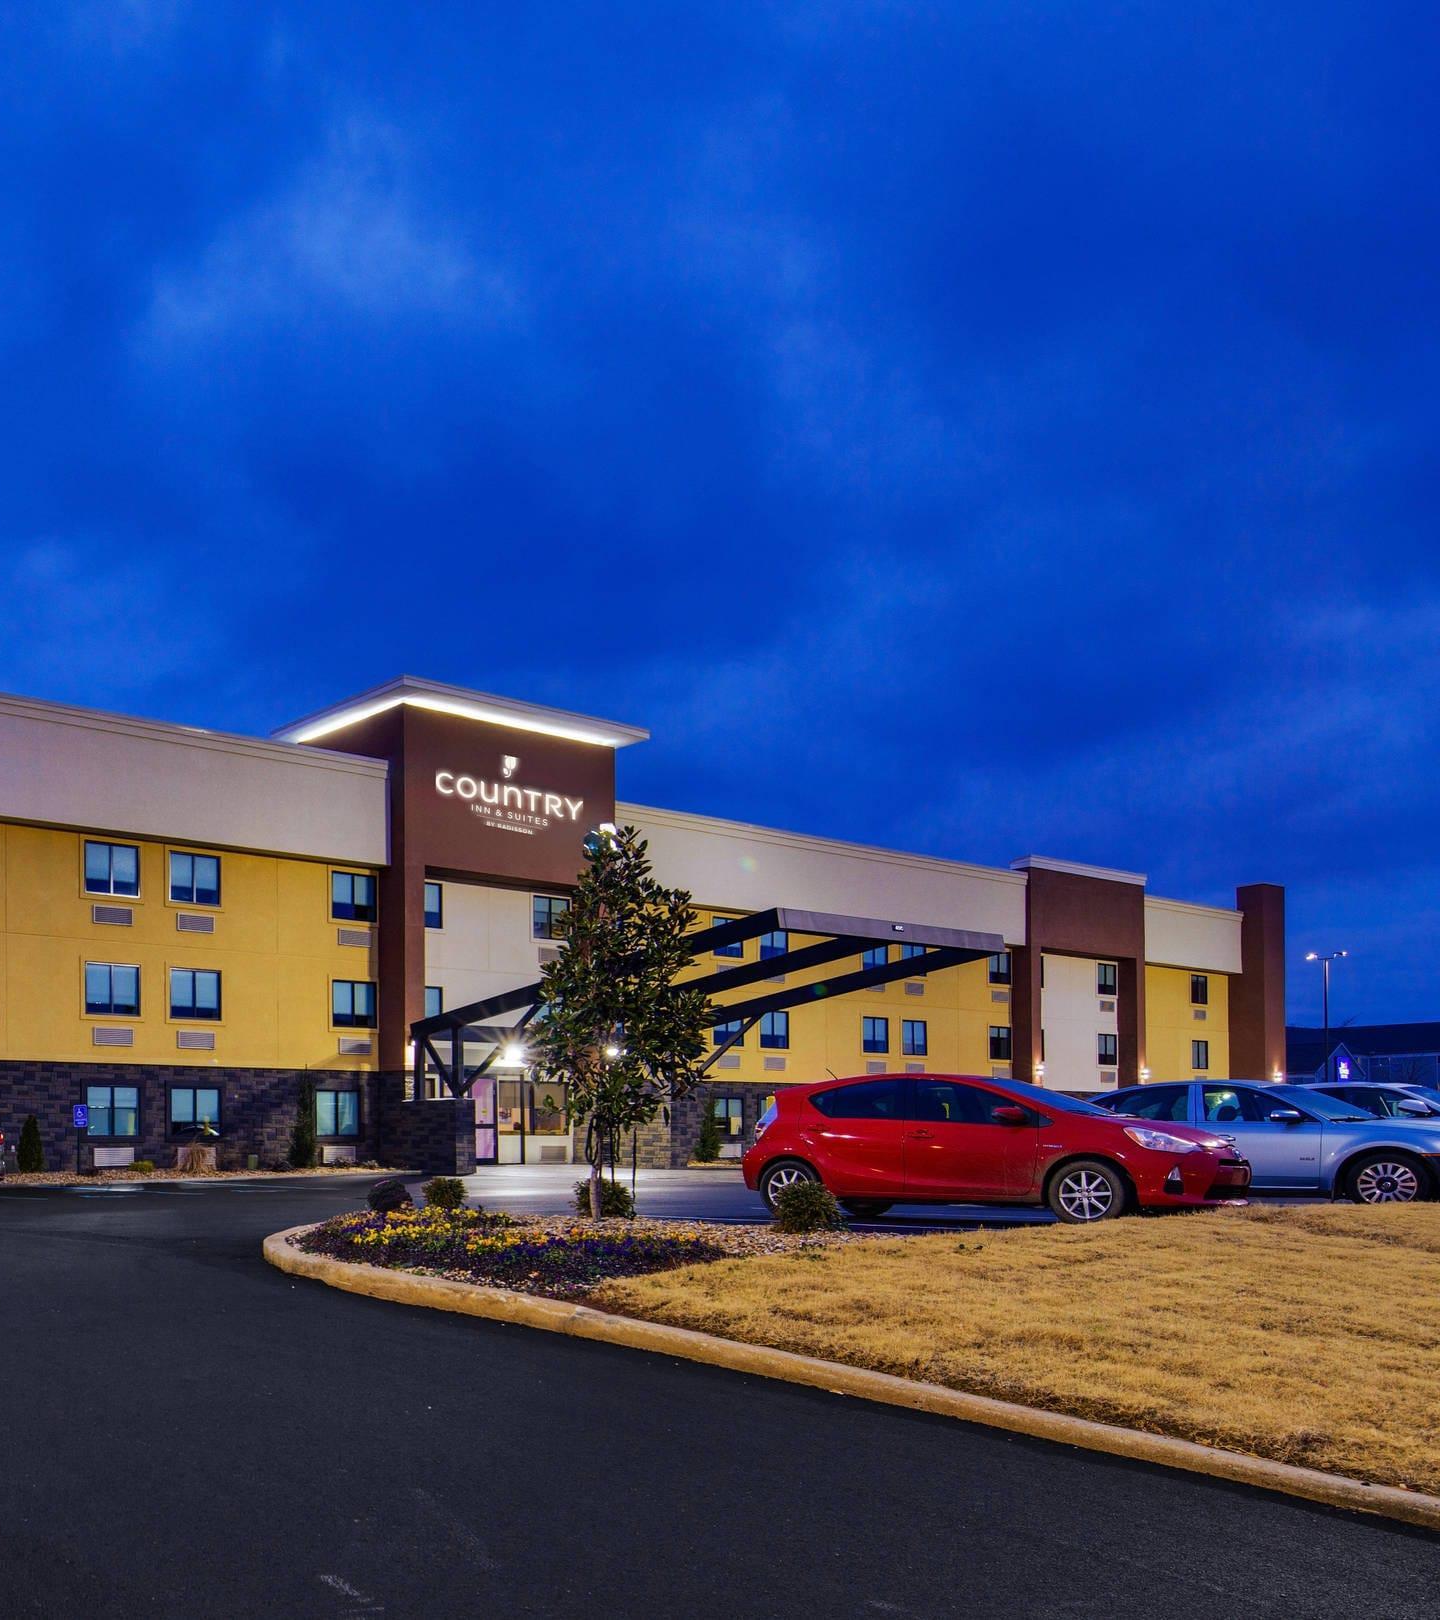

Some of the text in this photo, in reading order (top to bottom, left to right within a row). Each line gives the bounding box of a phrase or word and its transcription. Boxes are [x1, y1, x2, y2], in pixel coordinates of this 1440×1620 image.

[471, 803, 549, 827] INN & SUITES
[497, 823, 534, 835] RADISSON
